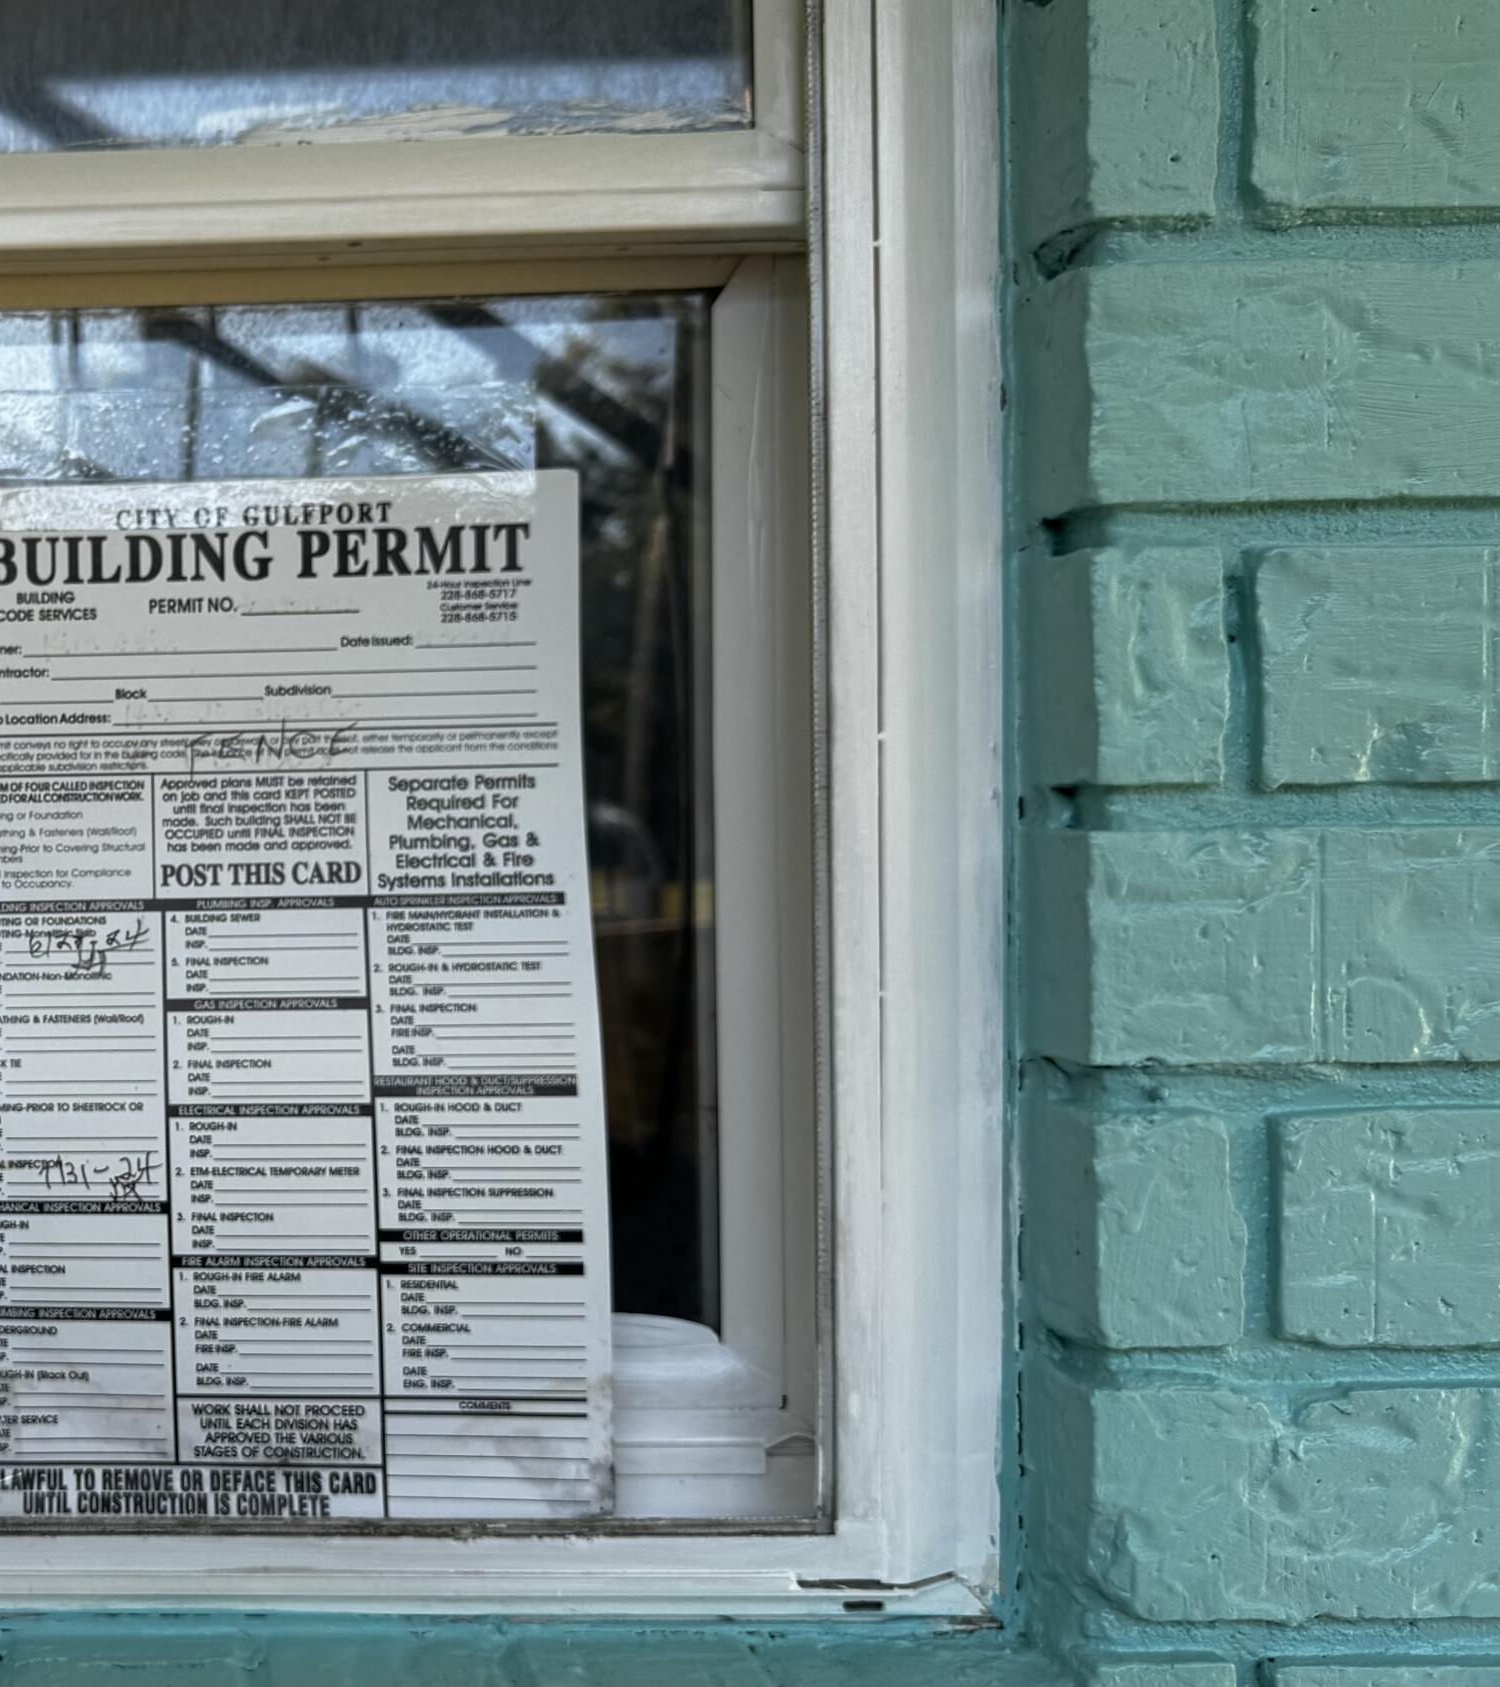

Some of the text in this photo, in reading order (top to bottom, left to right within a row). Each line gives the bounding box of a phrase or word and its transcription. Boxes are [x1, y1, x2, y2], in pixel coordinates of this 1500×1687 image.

[116, 502, 393, 530] CITY OF GULFPORT
[296, 522, 531, 579] PERMIT
[16, 591, 75, 605] BUILDING
[440, 589, 517, 601] 228-868-5717
[148, 598, 204, 614] PERMIT
[207, 598, 238, 613] NO.
[38, 608, 98, 621] SERVICES
[440, 612, 517, 623] 228-868-5715
[340, 635, 413, 648] Date Issued:
[115, 688, 148, 700] Block
[264, 685, 332, 698] Subdivision
[5, 713, 58, 725] Location
[59, 713, 111, 724] Address:
[388, 774, 536, 793] Separate Permits
[406, 794, 519, 813] Required For
[407, 814, 518, 830] Mechanical,
[389, 832, 540, 852] Plumbing, Gas &
[396, 852, 534, 869] Electrical & Fire
[160, 861, 362, 887] POST THIS CARD
[378, 872, 555, 892] Systems Installations
[30, 902, 86, 912] INSPECTION
[89, 901, 145, 911] APPROVALS
[25, 918, 39, 926] OR
[41, 916, 106, 925] FOUNDATIONS
[178, 1104, 360, 1115] ELECTRICAL INSPECTION APPROVALS
[43, 1202, 101, 1212] INSPECTION
[104, 1202, 161, 1212] APPROVALS
[12, 1265, 65, 1274] INSPECTION
[401, 1280, 459, 1289] RESIDENTIAL
[402, 1324, 471, 1332] COMMERCIAL
[192, 1404, 366, 1416] WORK SHALL NOT PROCEED
[200, 1419, 358, 1430] UNTIL EACH DIVISION HAS
[205, 1433, 353, 1444] APPROVED THE VARIOUS
[194, 1447, 365, 1459] STAGES OF CONSTRUCTION.
[73, 1469, 95, 1490] TO
[102, 1468, 174, 1491] REMOVE
[180, 1470, 204, 1491] OR
[210, 1470, 276, 1492] DEFACE
[282, 1471, 322, 1493] THIS
[329, 1472, 377, 1494] CARD
[23, 1492, 330, 1516] UNTIL CONSTRUCTION IS COMPLETE
